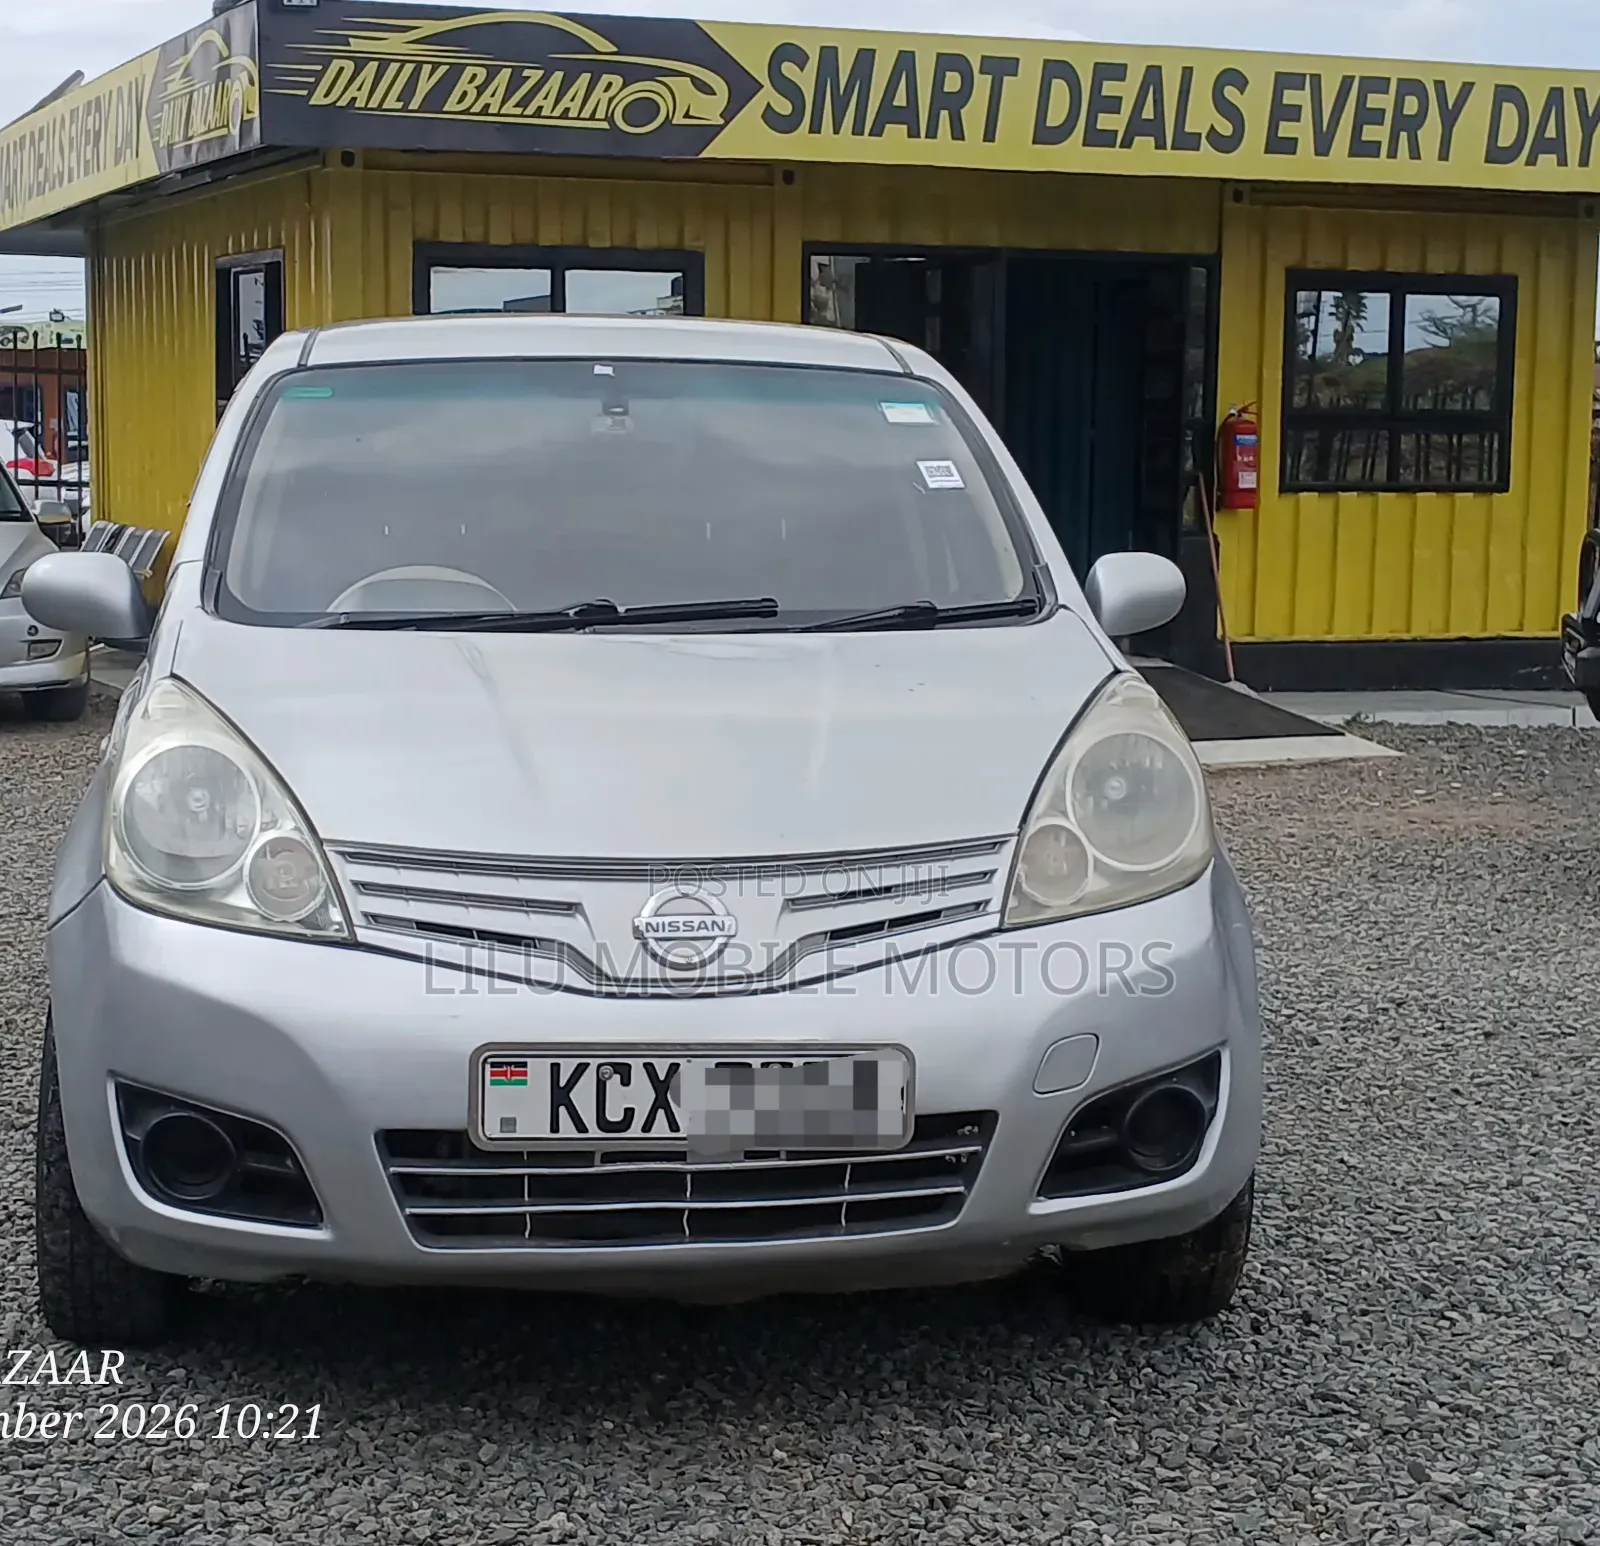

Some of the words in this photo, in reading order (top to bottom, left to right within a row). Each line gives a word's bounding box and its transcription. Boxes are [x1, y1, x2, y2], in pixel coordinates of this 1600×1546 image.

[308, 58, 450, 111] DAILY
[442, 66, 623, 120] BAZAAR
[761, 42, 1020, 143] SMART
[1032, 58, 1250, 154] DEALS
[1264, 71, 1477, 162] EVERY
[1484, 83, 1600, 168] DAY
[0, 133, 27, 212] ART
[28, 113, 66, 201] DEALS
[67, 89, 113, 185] EVERY
[114, 74, 146, 167] DAY
[645, 919, 726, 933] NISSAN
[549, 1061, 681, 1134] KCX
